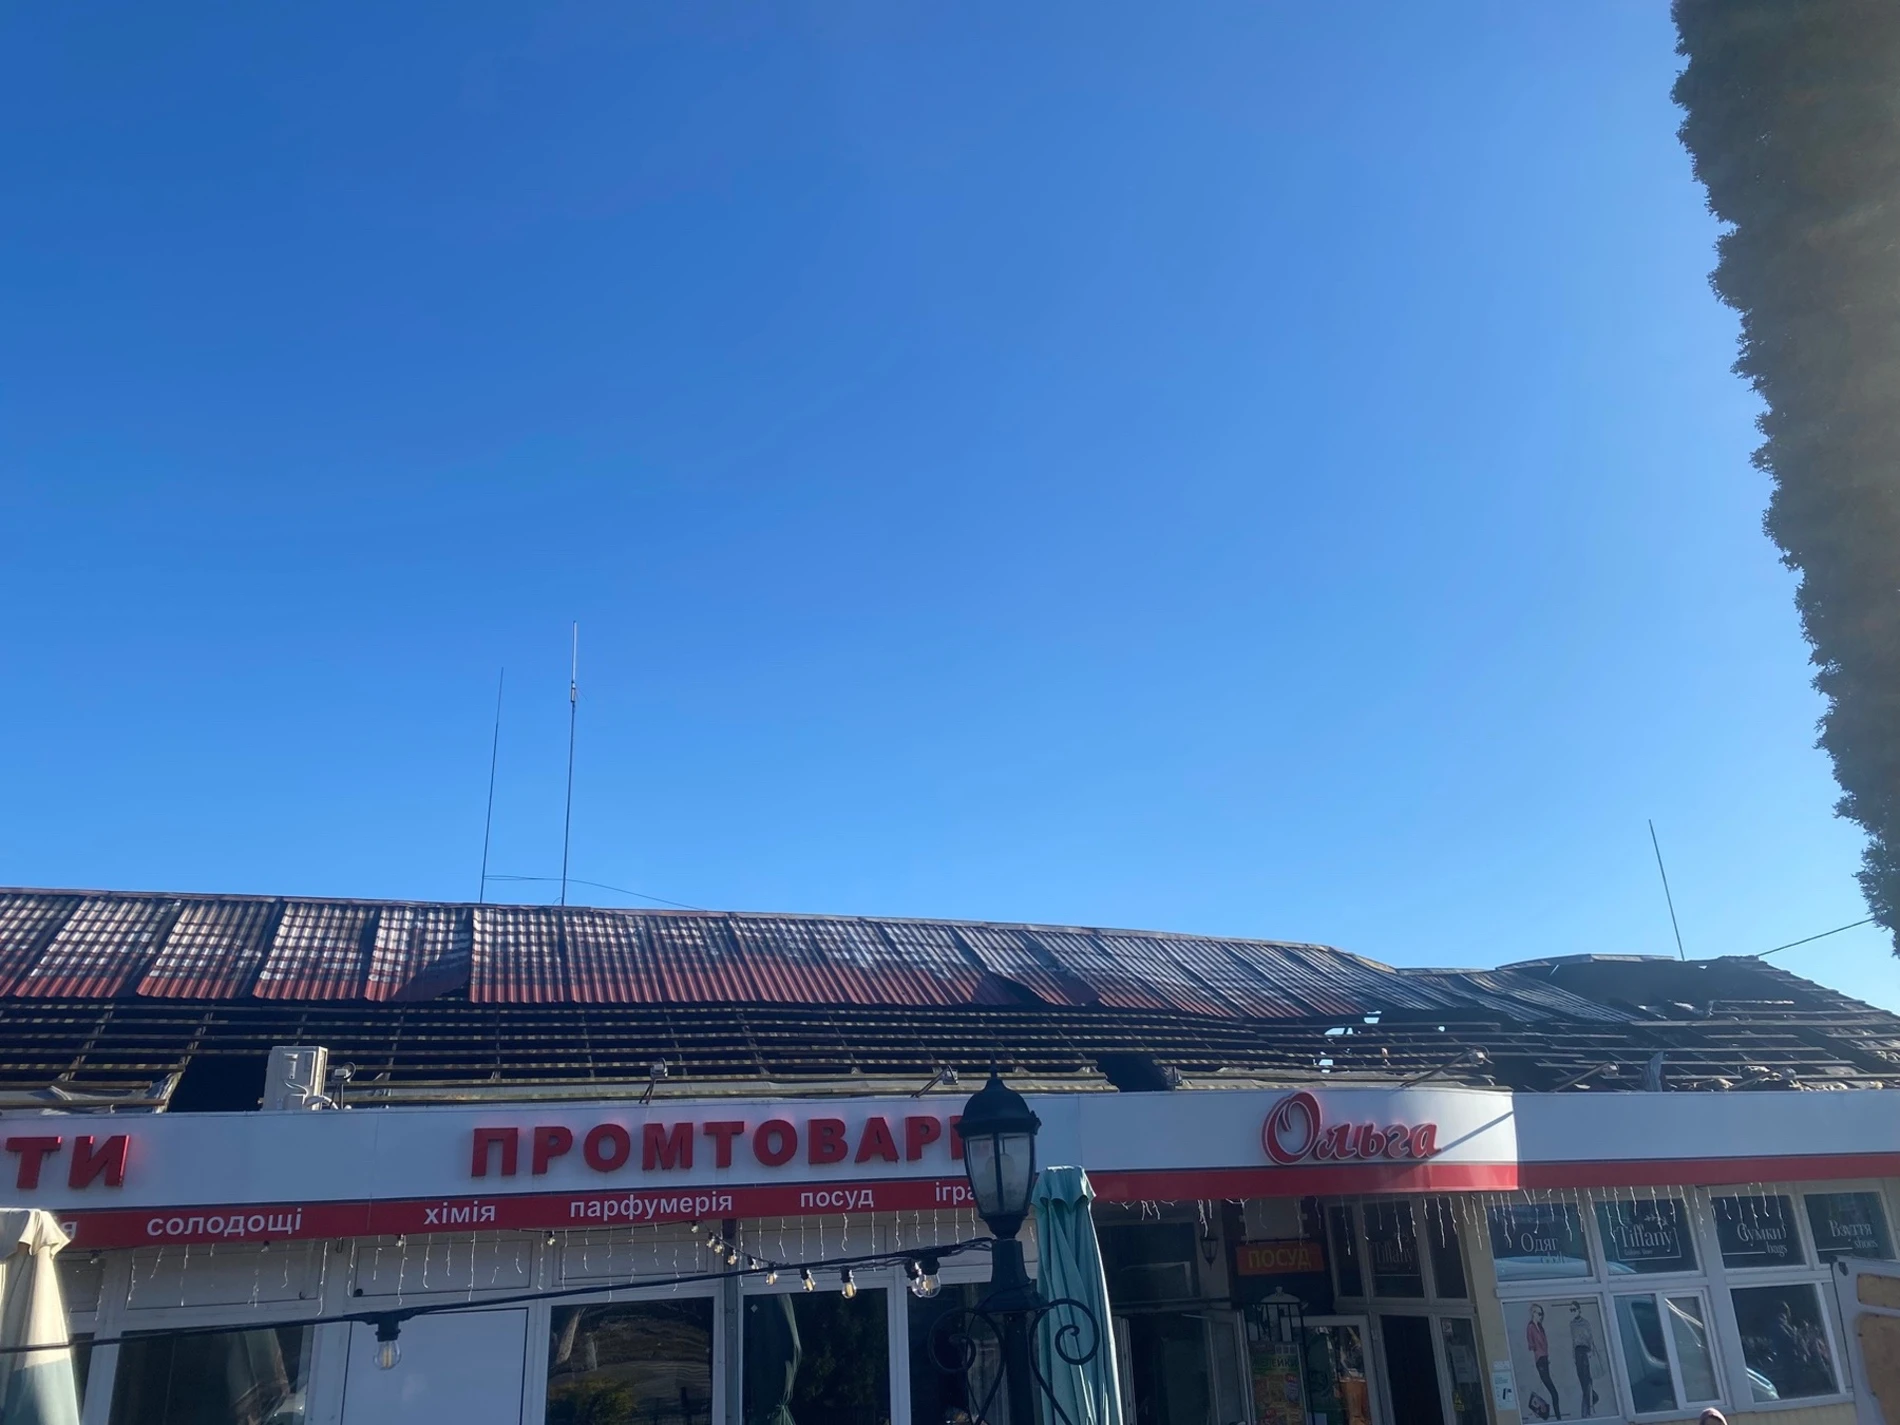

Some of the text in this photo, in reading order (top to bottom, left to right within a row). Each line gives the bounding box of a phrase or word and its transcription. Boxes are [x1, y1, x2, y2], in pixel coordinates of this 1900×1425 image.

[1261, 1091, 1441, 1166] Ольга
[146, 1208, 302, 1238] солодощі
[424, 1200, 496, 1226] хімія
[569, 1190, 733, 1221] парфумерія
[800, 1185, 874, 1211] посуд
[1520, 1232, 1559, 1253] Одяг
[1617, 1223, 1672, 1252] Tiffany
[1766, 1242, 1788, 1257] bags
[1247, 1248, 1312, 1270] ПОСУД
